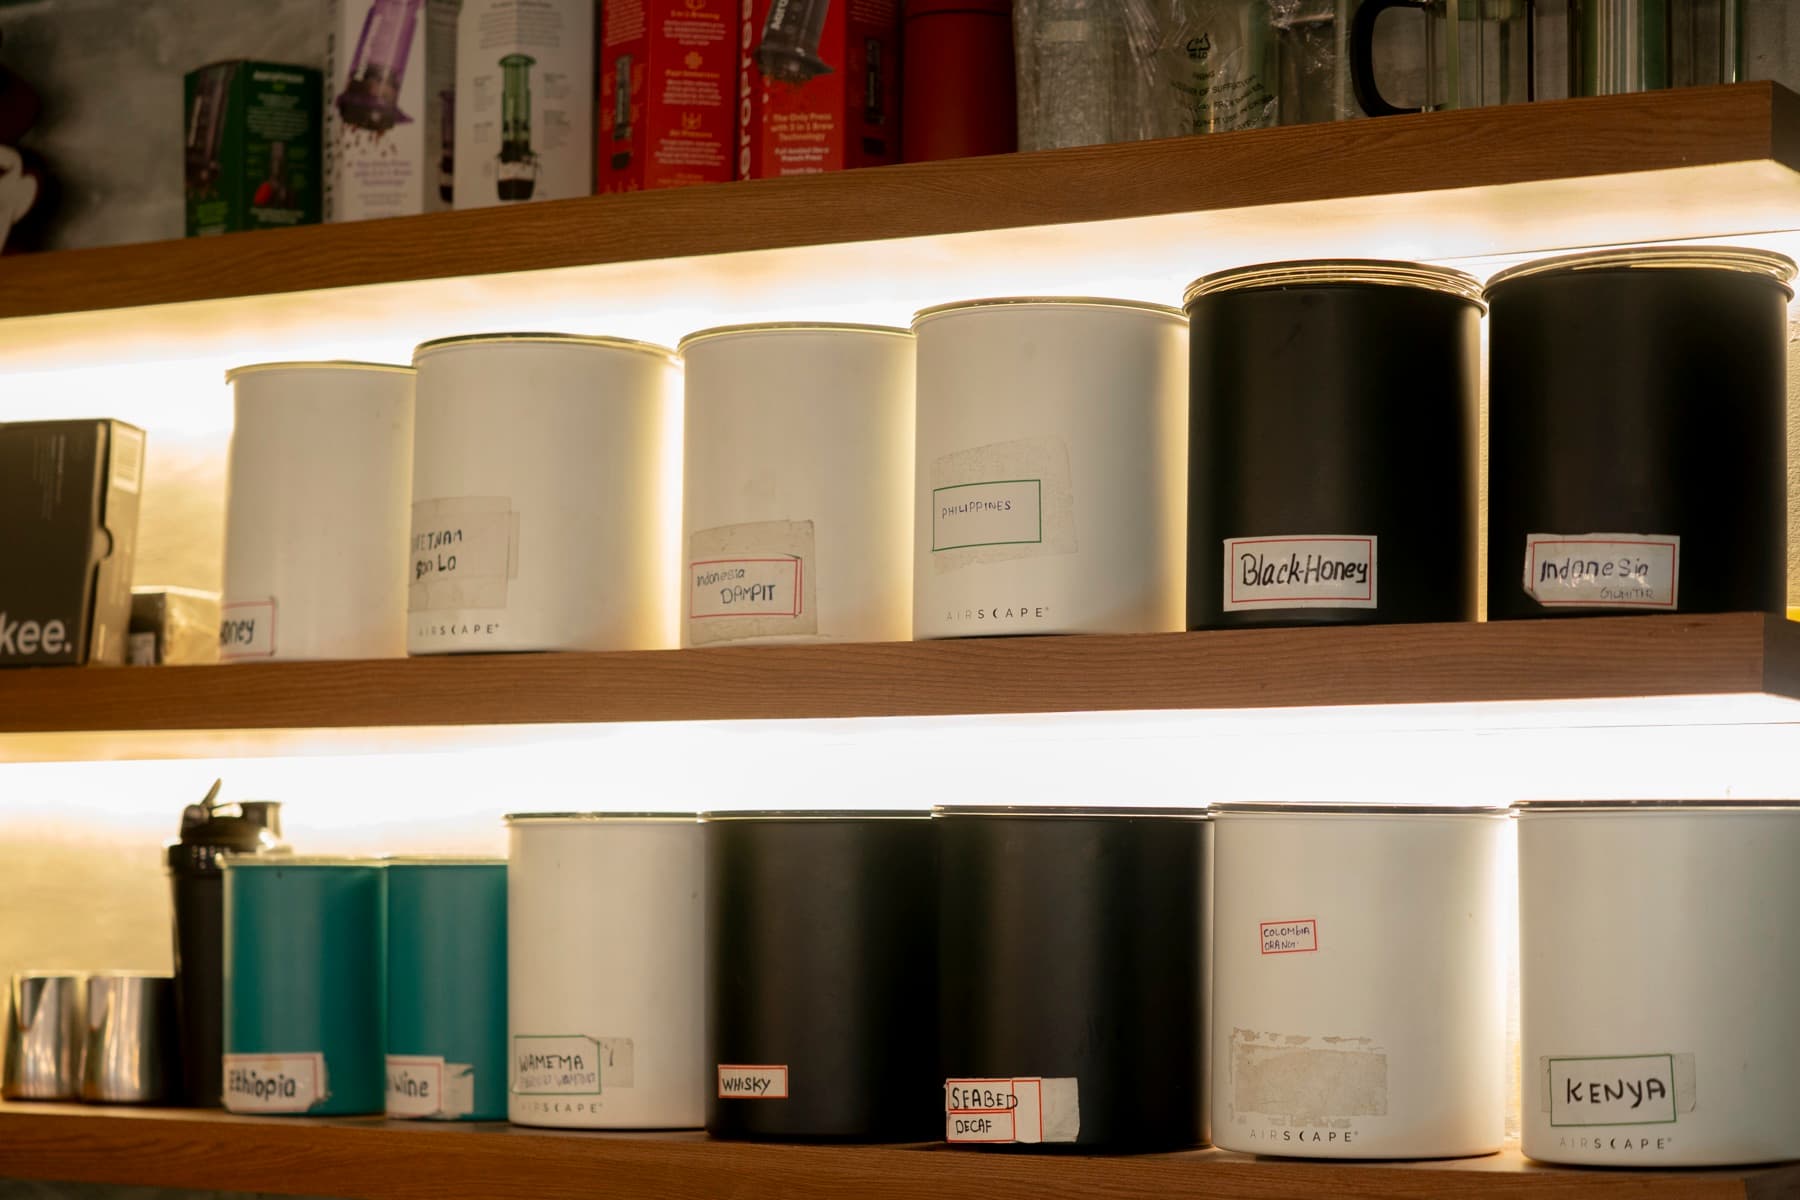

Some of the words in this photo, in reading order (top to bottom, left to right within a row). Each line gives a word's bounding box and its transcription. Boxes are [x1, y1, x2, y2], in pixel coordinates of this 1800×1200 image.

[942, 500, 1012, 519] PHILIPPINES
[720, 583, 776, 604] DAMPIT
[220, 617, 256, 645] oney
[951, 1087, 1019, 1110] SEABED
[1566, 1078, 1667, 1109] KENYA
[955, 1118, 993, 1136] DECAF
